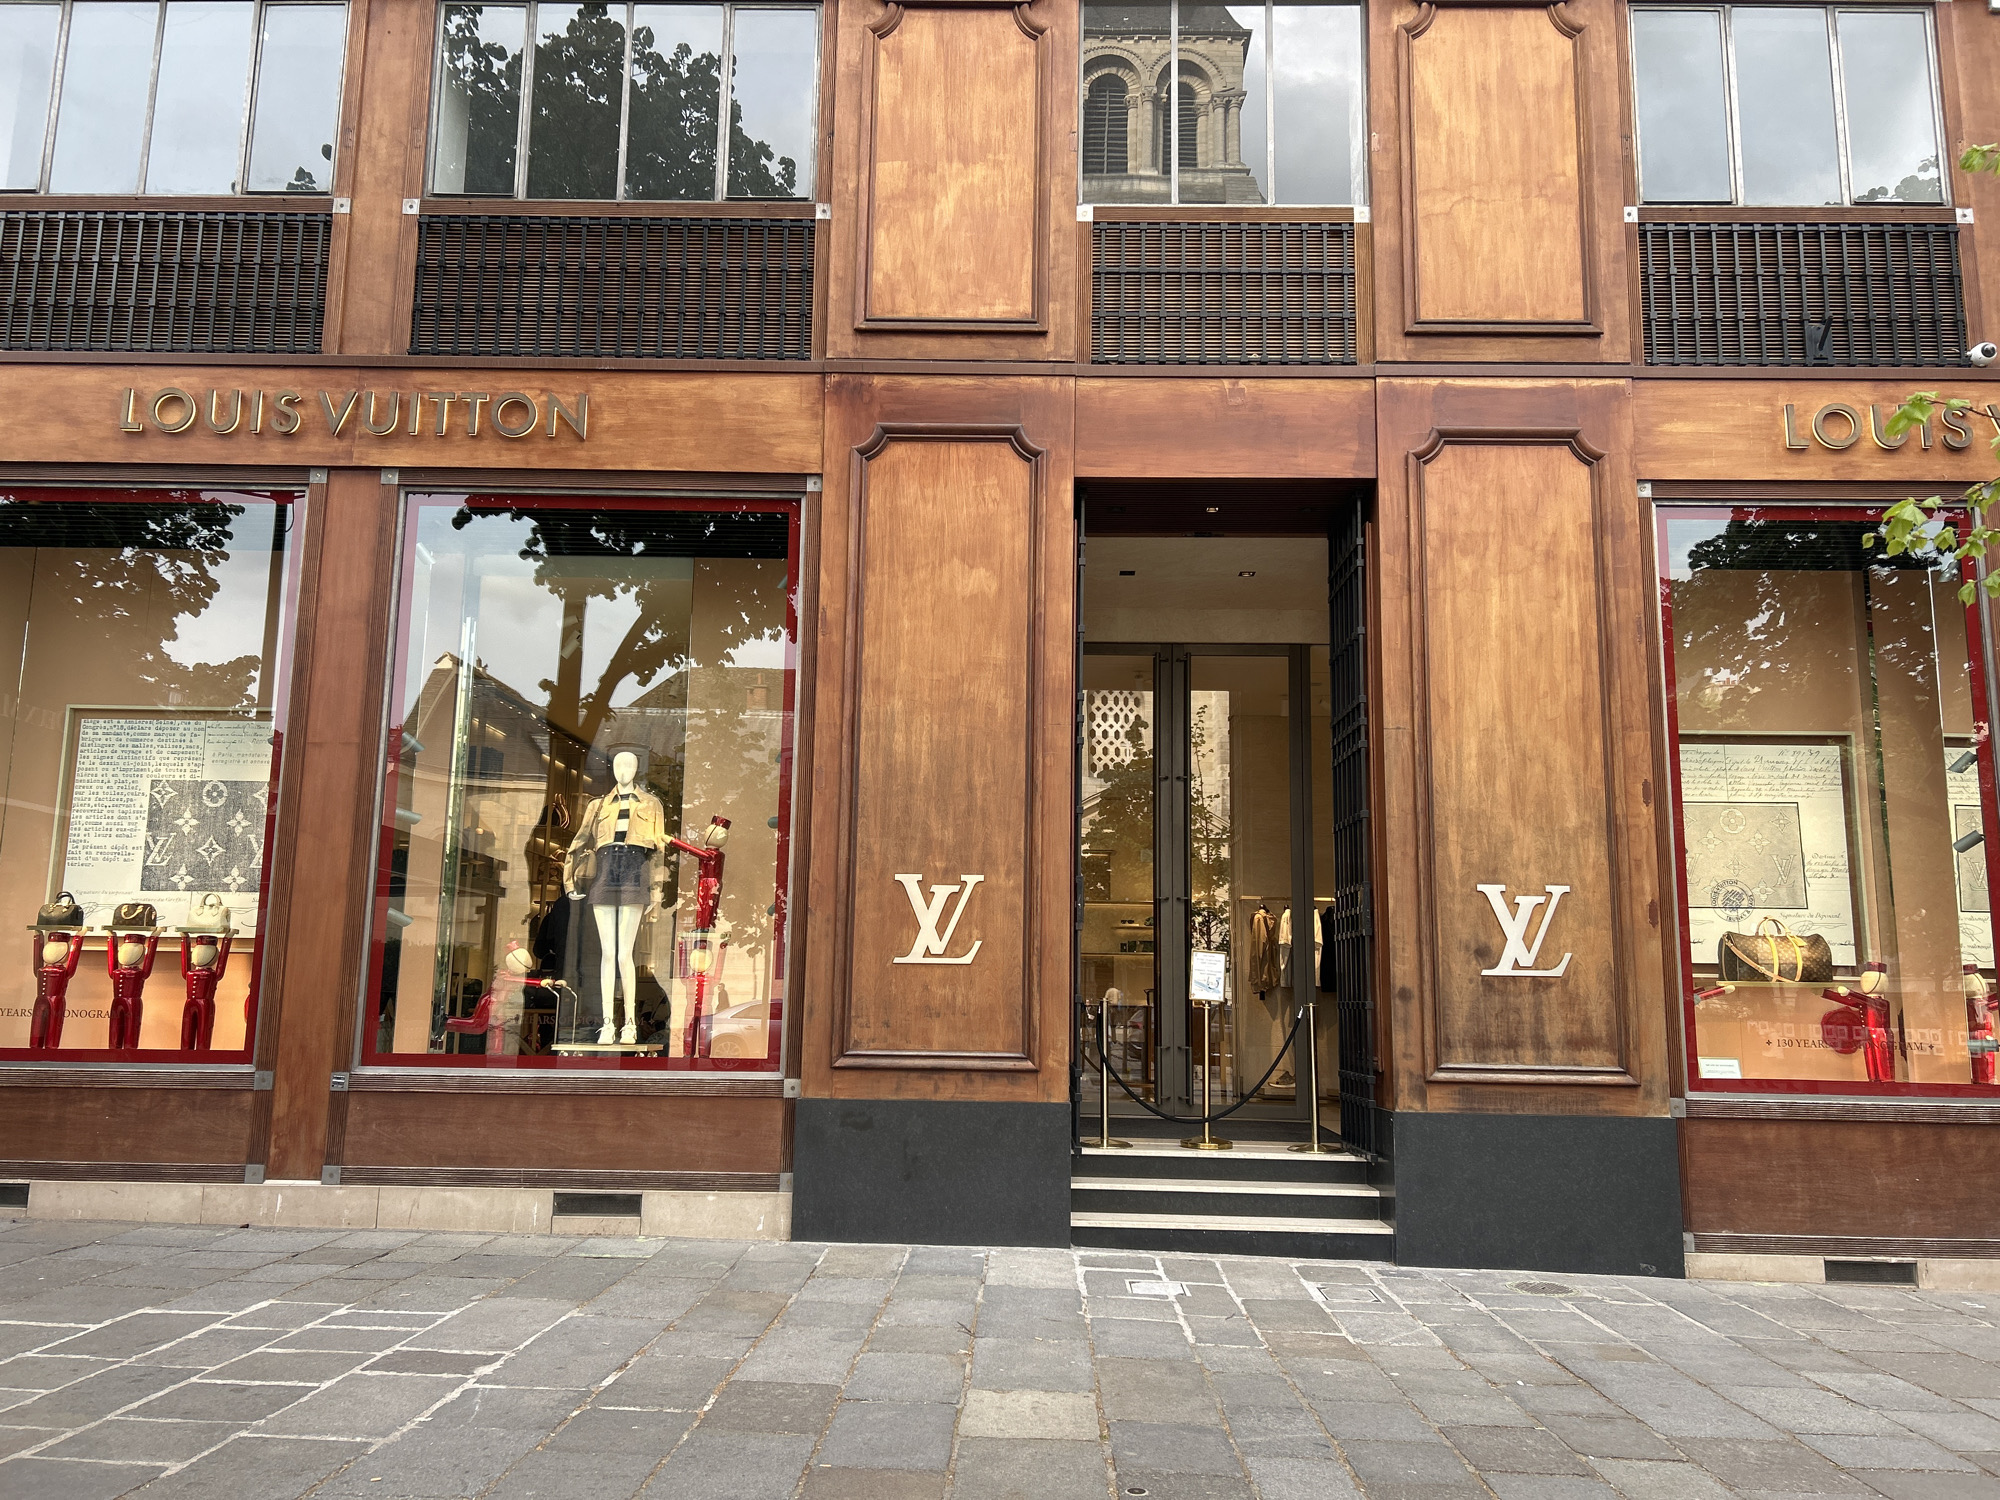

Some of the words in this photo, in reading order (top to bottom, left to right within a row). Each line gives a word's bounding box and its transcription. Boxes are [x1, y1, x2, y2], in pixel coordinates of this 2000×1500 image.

[119, 387, 302, 434] LOUIS
[318, 390, 589, 441] VUITTON
[1784, 402, 1974, 450] LOUIS
[64, 1009, 111, 1019] ONOGRA
[1776, 1038, 1793, 1048] 130
